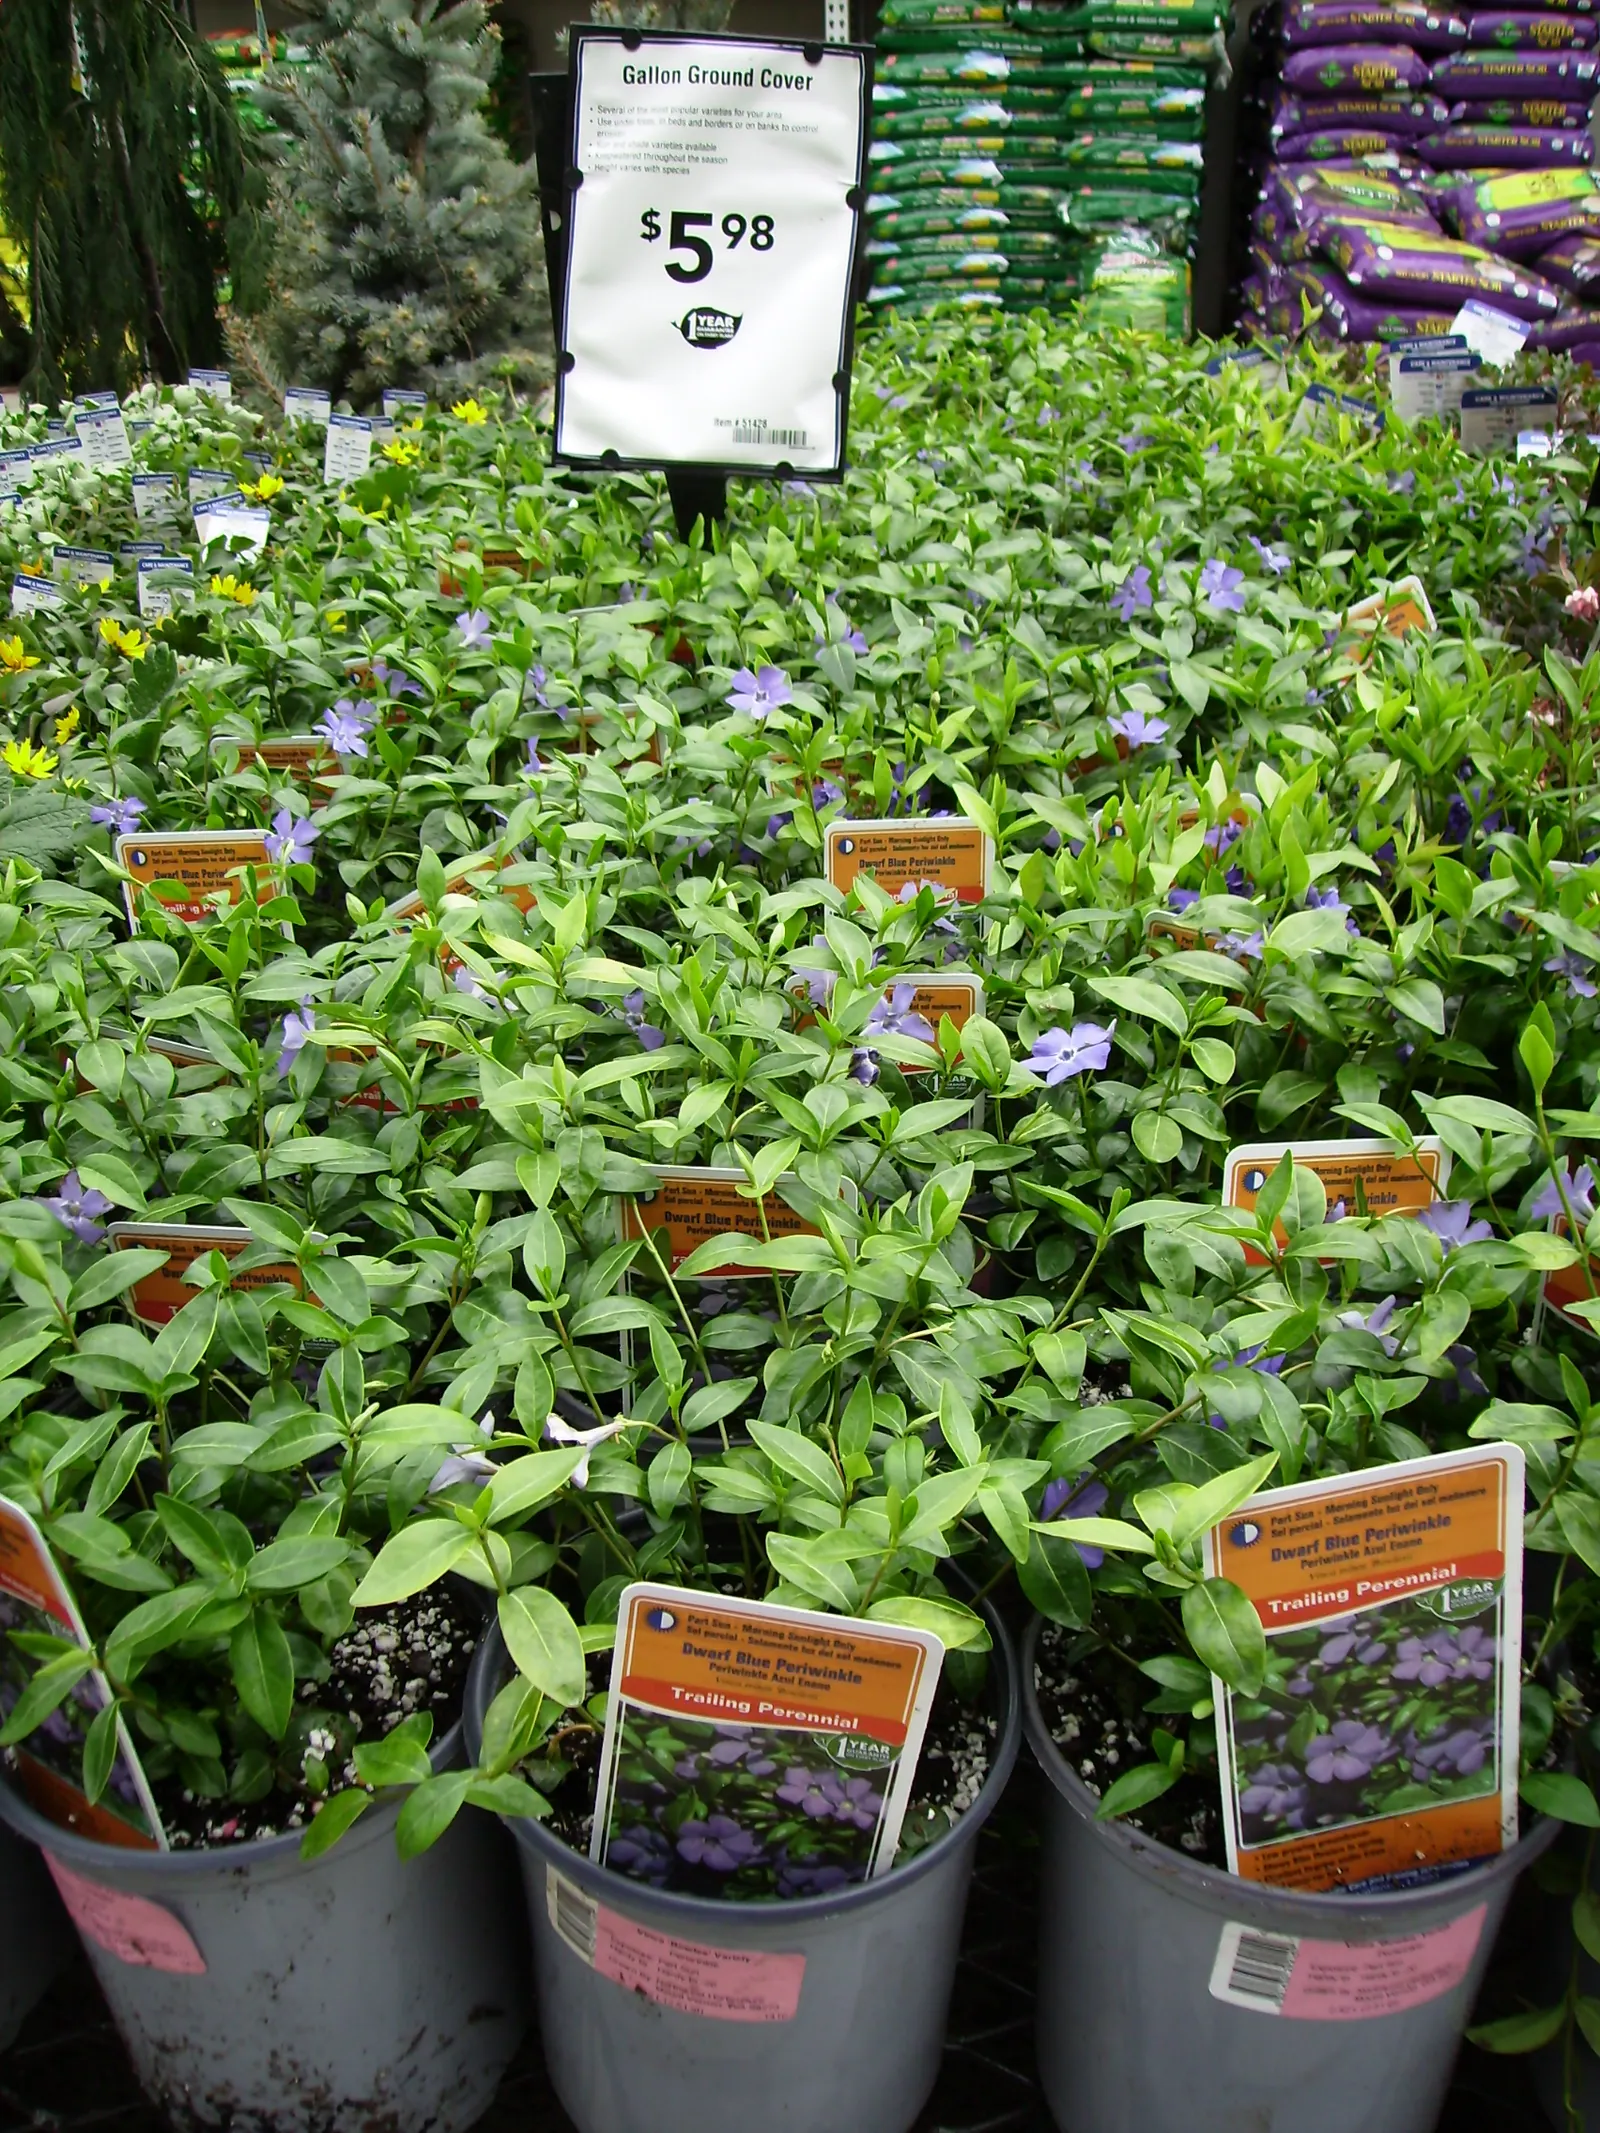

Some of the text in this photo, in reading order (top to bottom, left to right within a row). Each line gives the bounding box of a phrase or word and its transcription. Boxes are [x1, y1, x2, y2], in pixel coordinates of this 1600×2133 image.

[623, 64, 814, 91] Gallon Ground Cover
[597, 105, 625, 114] Several
[701, 107, 732, 117] varieties
[734, 108, 744, 117] for
[746, 109, 763, 119] your
[597, 118, 612, 126] Use
[668, 118, 686, 127] beds
[688, 118, 702, 127] and
[704, 119, 733, 129] borders
[735, 121, 743, 129] or
[757, 121, 779, 131] banks
[782, 123, 790, 132] to
[791, 124, 819, 133] control
[643, 153, 728, 165] throughout the season
[651, 142, 717, 152] varieties available
[644, 164, 660, 173] with
[662, 166, 690, 175] species
[687, 311, 735, 340] 1 YEAR
[859, 856, 955, 868] Dwarf Blue Periwinkle
[1376, 1163, 1392, 1173] Only
[664, 1211, 700, 1224] Dwarf
[705, 1213, 731, 1226] Blue
[236, 1272, 290, 1284] eriwinkle
[1271, 1484, 1438, 1526] Part Sun Morning Sunlight Only
[1271, 1529, 1287, 1538] Sol
[1290, 1520, 1322, 1537] parcial
[1333, 1508, 1383, 1525] Solamente
[1271, 1514, 1452, 1563] Dwarf Blue Periwinkle
[1301, 1549, 1359, 1570] Periwinkle
[1364, 1543, 1386, 1557] Azul
[1390, 1537, 1423, 1551] Enano
[1268, 1563, 1457, 1614] Trailing Perennial
[1441, 1589, 1452, 1613] 1
[1452, 1582, 1494, 1598] YEAR
[686, 1626, 702, 1636] Sol
[704, 1630, 737, 1643] parcial
[748, 1636, 799, 1652] Solamente
[819, 1648, 833, 1658] del
[836, 1651, 851, 1661] sol
[688, 1614, 856, 1652] Part Sun Morning Sunlight Only
[682, 1642, 863, 1685] Dwarf Blue Periwinkle
[709, 1662, 768, 1681] Periwinkle
[771, 1672, 795, 1685] Azul
[798, 1678, 831, 1692] Enano
[671, 1686, 752, 1714] Trailing
[758, 1702, 859, 1731] Perennial
[836, 1737, 848, 1759] 1
[849, 1741, 891, 1754] YEAR
